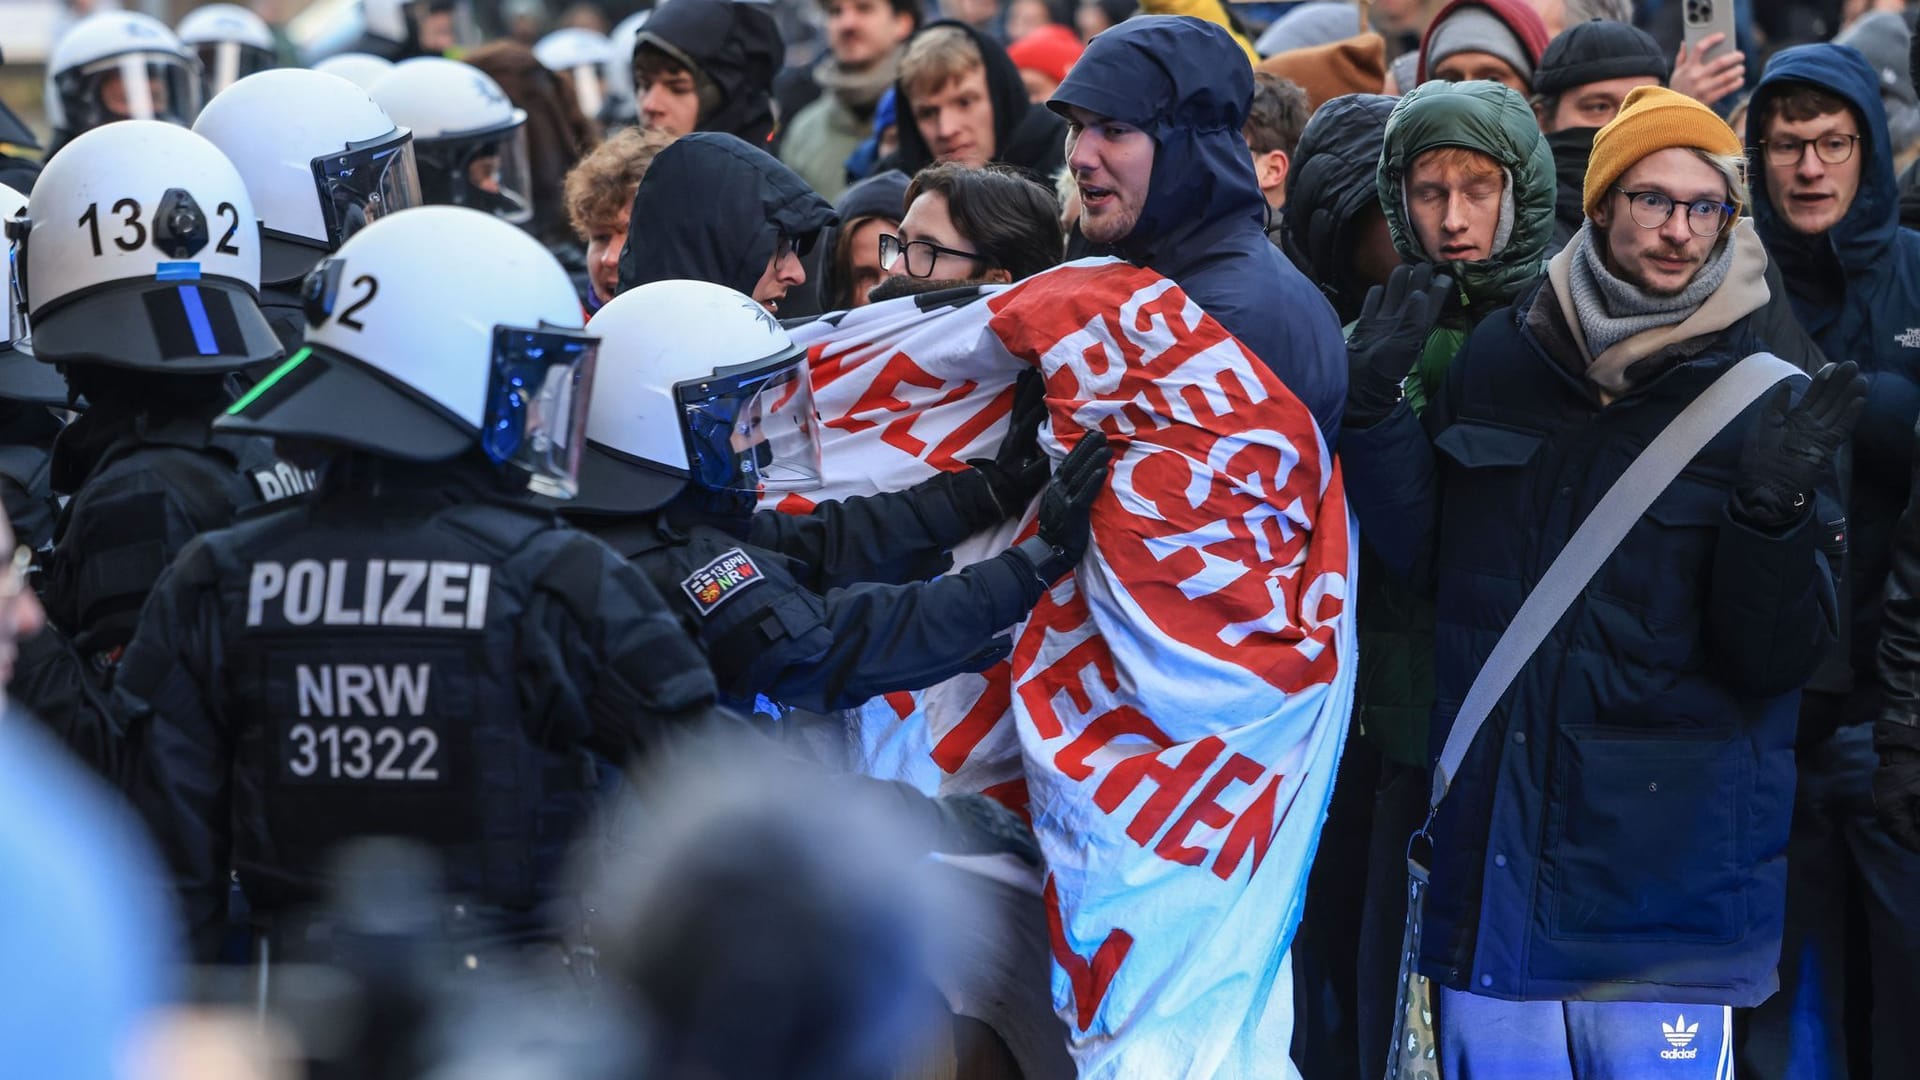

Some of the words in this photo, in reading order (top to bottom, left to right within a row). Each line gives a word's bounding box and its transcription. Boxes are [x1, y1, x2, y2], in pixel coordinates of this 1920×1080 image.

[215, 201, 239, 257] 2
[337, 274, 378, 332] 2
[247, 558, 491, 630] POLIZEI
[717, 563, 753, 590] NRW
[296, 664, 430, 717] NRW
[289, 723, 439, 780] 31322
[1660, 1048, 1697, 1060] adidas
